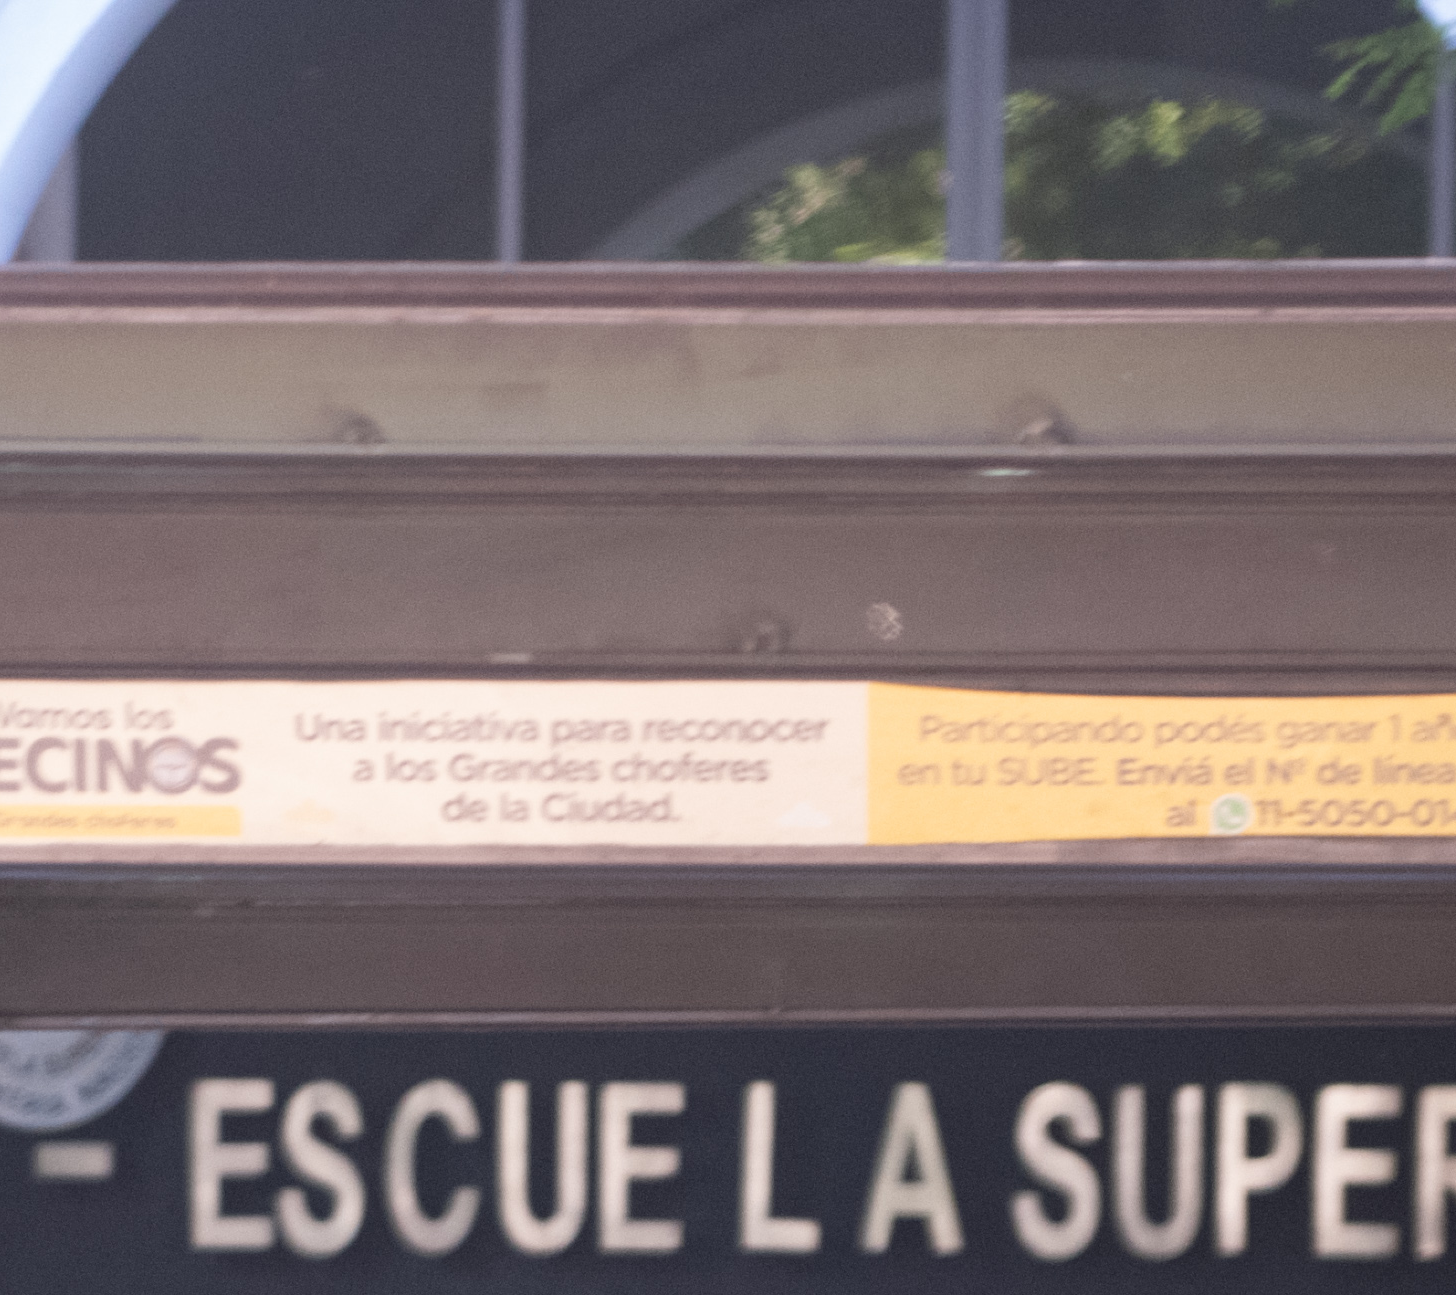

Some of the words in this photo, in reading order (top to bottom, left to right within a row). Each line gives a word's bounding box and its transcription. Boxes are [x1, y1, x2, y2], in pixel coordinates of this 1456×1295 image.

[124, 701, 175, 729] los
[294, 712, 366, 742] Una
[377, 711, 539, 742] iniciativa
[550, 717, 631, 748] para
[641, 717, 829, 742] reconocer
[919, 714, 1145, 748] Participando
[1153, 713, 1266, 749] podés
[1276, 719, 1377, 749] ganar
[352, 759, 374, 782] a
[384, 752, 436, 782] los
[447, 753, 601, 782] Grandes
[610, 751, 771, 783] choferes
[897, 762, 942, 786] en
[951, 758, 986, 786] tu
[1223, 757, 1254, 786] el
[1316, 756, 1361, 785] de
[441, 792, 488, 822] de
[499, 792, 529, 822] la
[540, 792, 683, 823] Ciudad.
[1166, 799, 1197, 828] al
